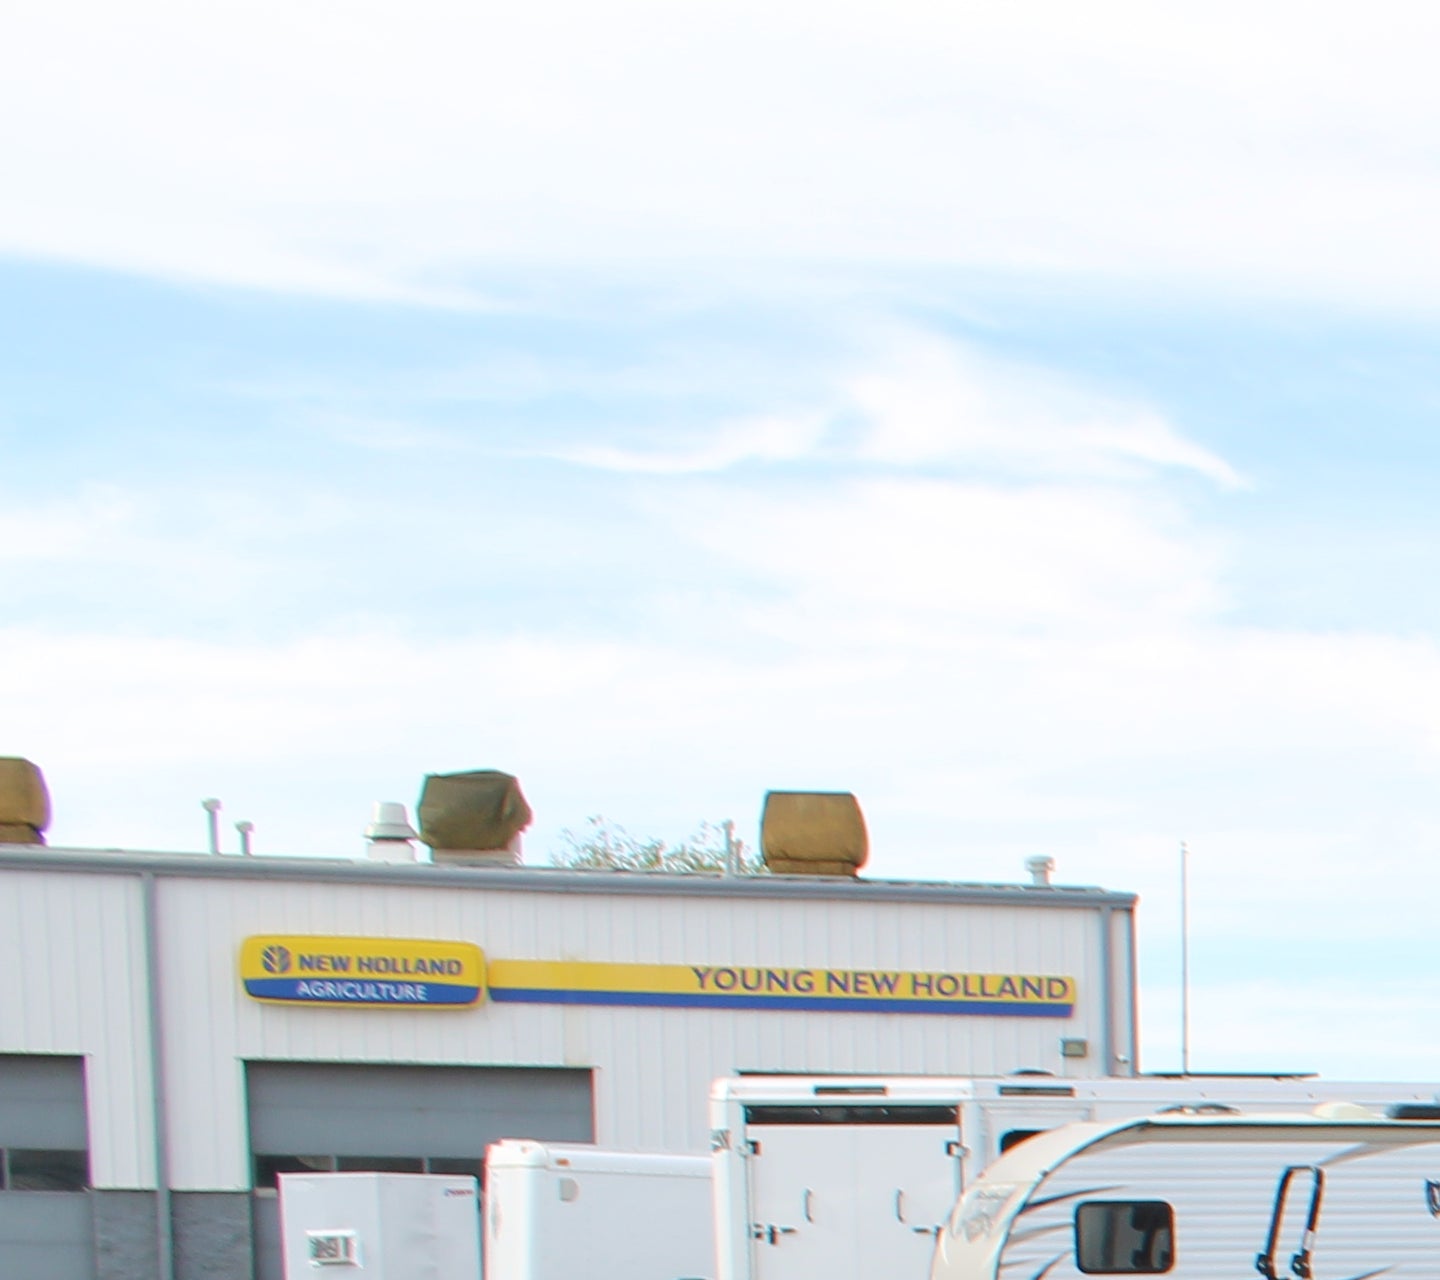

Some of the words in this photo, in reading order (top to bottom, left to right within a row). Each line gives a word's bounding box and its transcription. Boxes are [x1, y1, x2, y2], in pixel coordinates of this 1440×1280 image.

[299, 953, 350, 972] NEW
[357, 956, 463, 976] HOLLAND
[296, 980, 428, 1001] AGRICULTURE
[692, 967, 814, 993] YOUNG
[826, 971, 902, 995] NEW
[911, 973, 1069, 1000] HOLLAND
